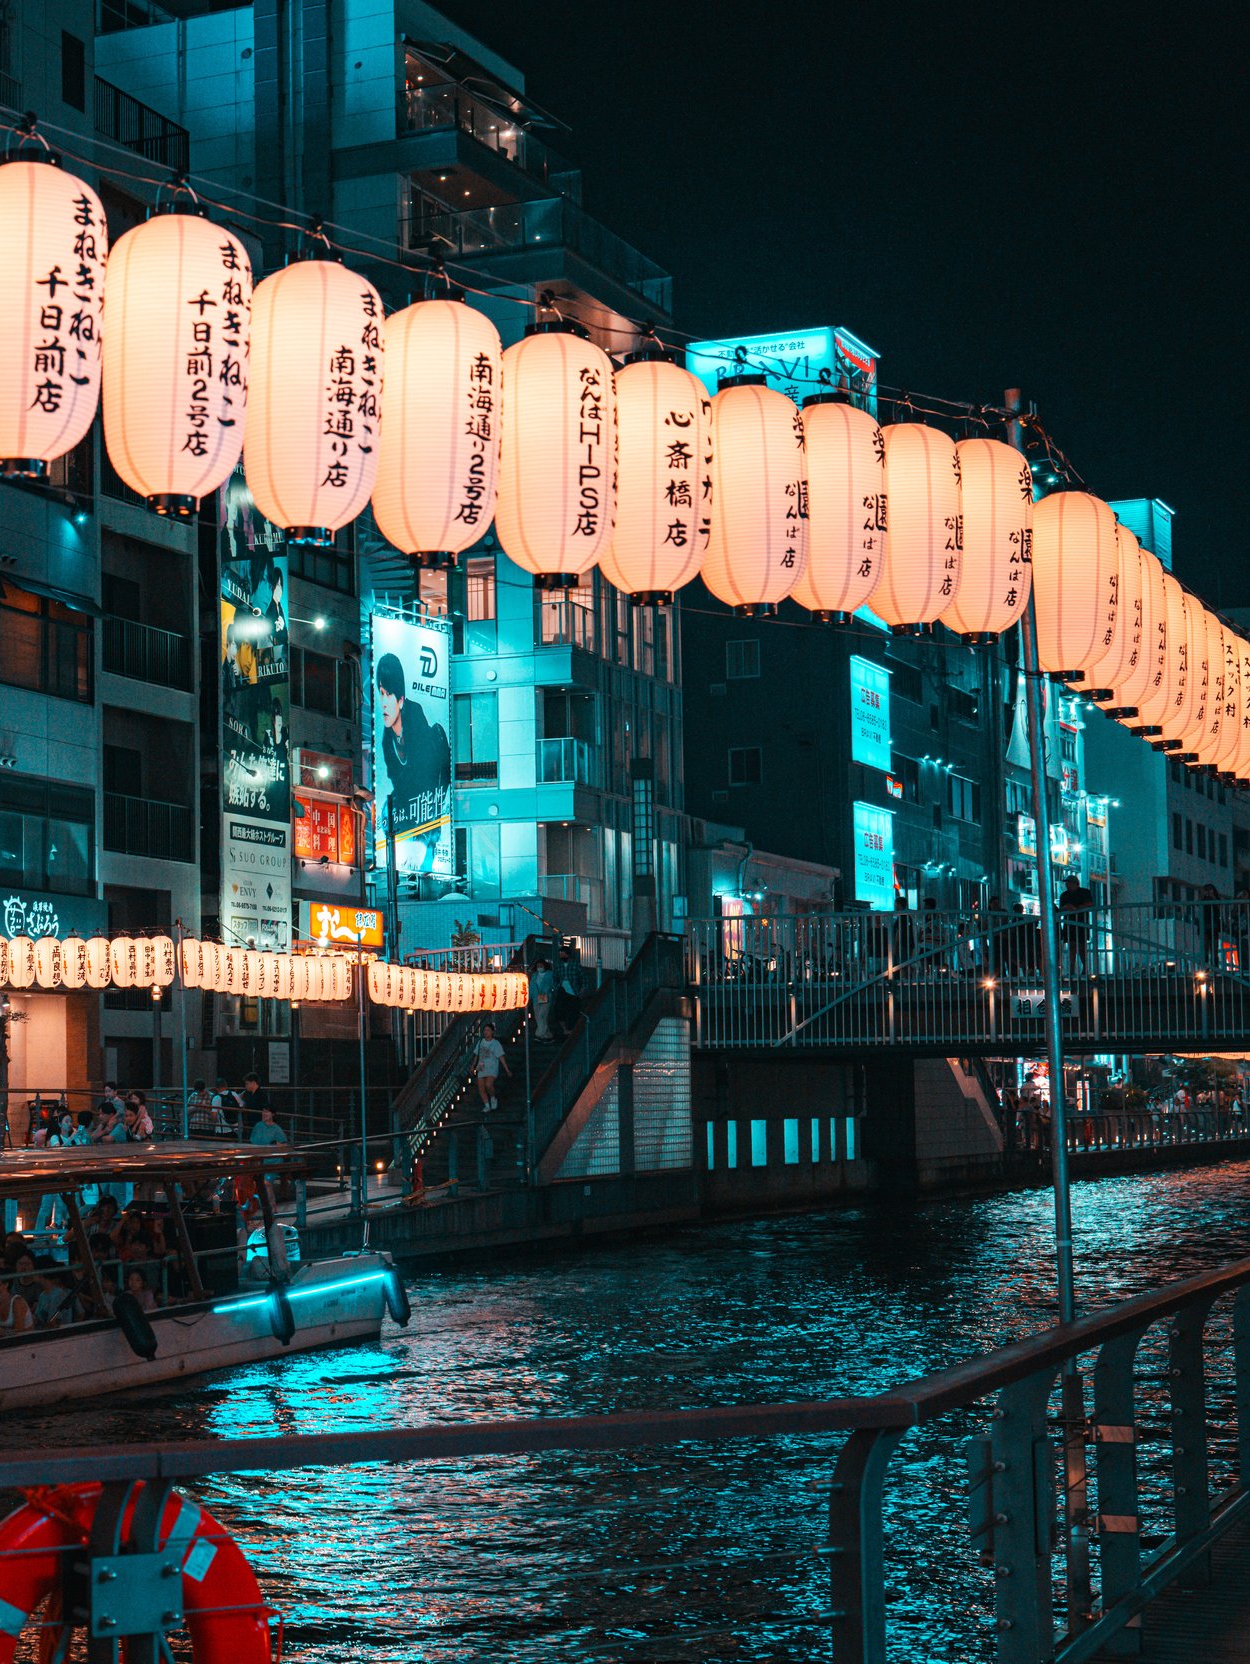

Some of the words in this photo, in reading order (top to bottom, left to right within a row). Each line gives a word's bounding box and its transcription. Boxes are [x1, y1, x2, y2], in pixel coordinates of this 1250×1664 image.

[28, 265, 69, 414] 千日前店
[65, 193, 97, 387] まねきねこ
[217, 239, 244, 428] まねきねこ
[181, 289, 217, 457] 千日前2号店
[321, 344, 357, 488] 南海通り店
[357, 288, 382, 455] まねきねこ
[454, 352, 494, 526] 南海通り2号店
[572, 366, 604, 537] なんばHIPS店
[662, 409, 695, 547] 心斎橋店
[780, 483, 801, 569] なんば店
[857, 494, 877, 578] なんば店
[939, 516, 958, 596] なんば店
[1003, 530, 1023, 607] なんば店
[258, 662, 286, 678] RIKUTO
[259, 854, 287, 869] GROUP
[312, 809, 336, 829] 中国
